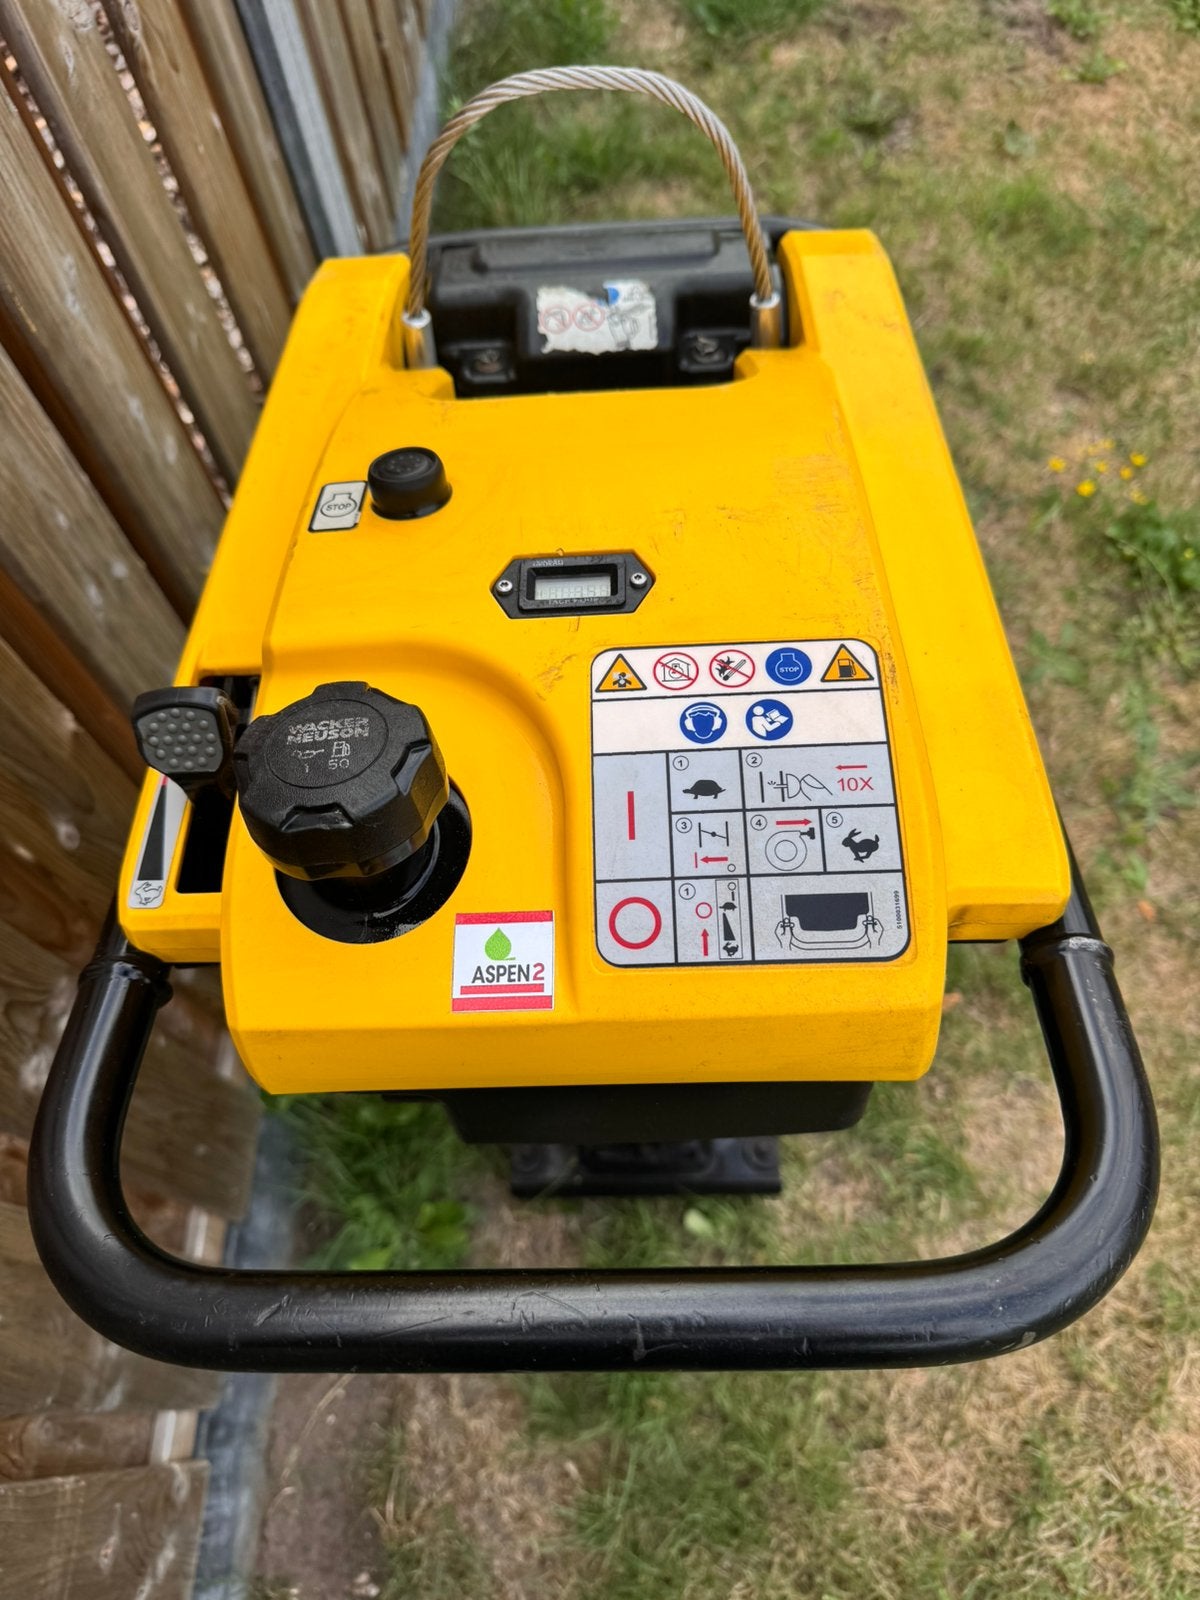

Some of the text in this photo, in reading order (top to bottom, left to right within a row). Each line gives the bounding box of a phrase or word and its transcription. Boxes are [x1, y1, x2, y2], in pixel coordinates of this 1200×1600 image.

[326, 503, 352, 512] STOP
[779, 666, 800, 674] STOP
[288, 717, 370, 735] WACKER
[286, 727, 370, 745] NEUSON
[837, 776, 875, 792] 10X
